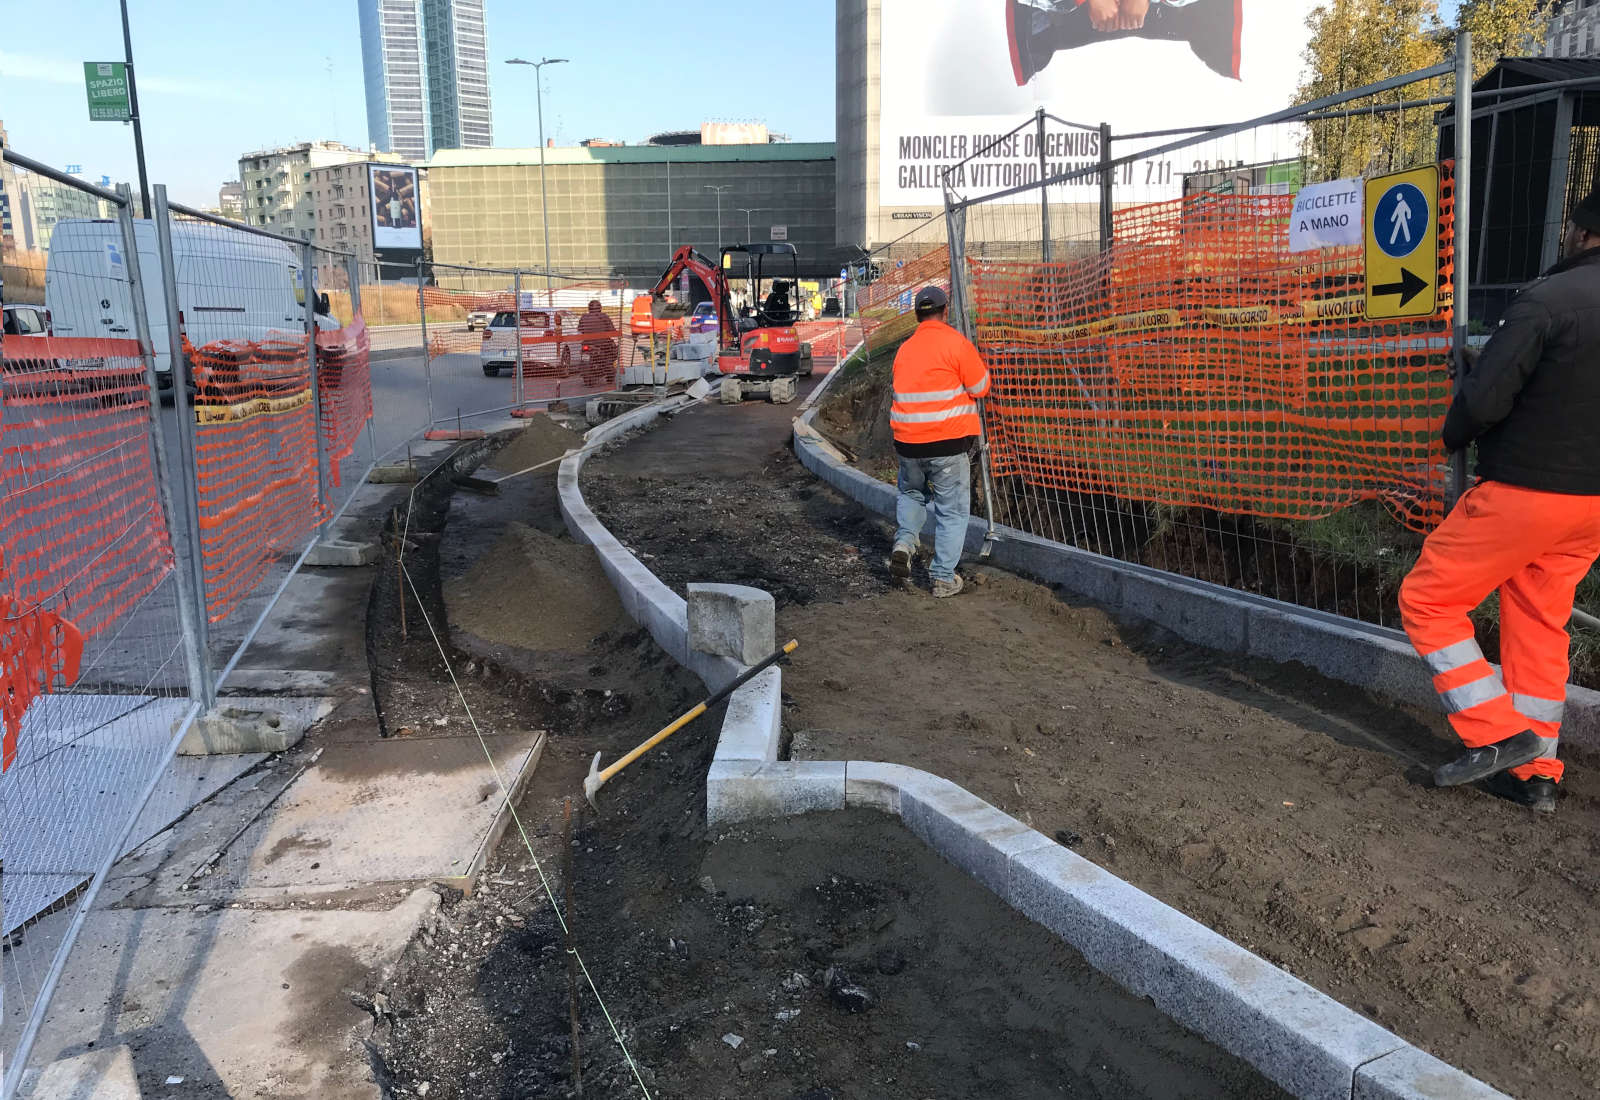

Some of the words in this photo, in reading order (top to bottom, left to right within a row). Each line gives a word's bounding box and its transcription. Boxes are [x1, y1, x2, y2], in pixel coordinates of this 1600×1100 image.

[90, 78, 123, 89] SPAZIO
[91, 87, 126, 98] LIBERO
[899, 135, 967, 159] MONCLER
[973, 133, 1020, 158] HOUSE
[1046, 132, 1099, 157] GENIUS
[898, 164, 967, 188] GALLERIA
[971, 163, 1038, 187] VITTORIO
[1145, 160, 1171, 184] 7.11
[1296, 191, 1357, 212] BICICLETTE
[1300, 220, 1309, 232] A
[1311, 214, 1349, 230] MANO
